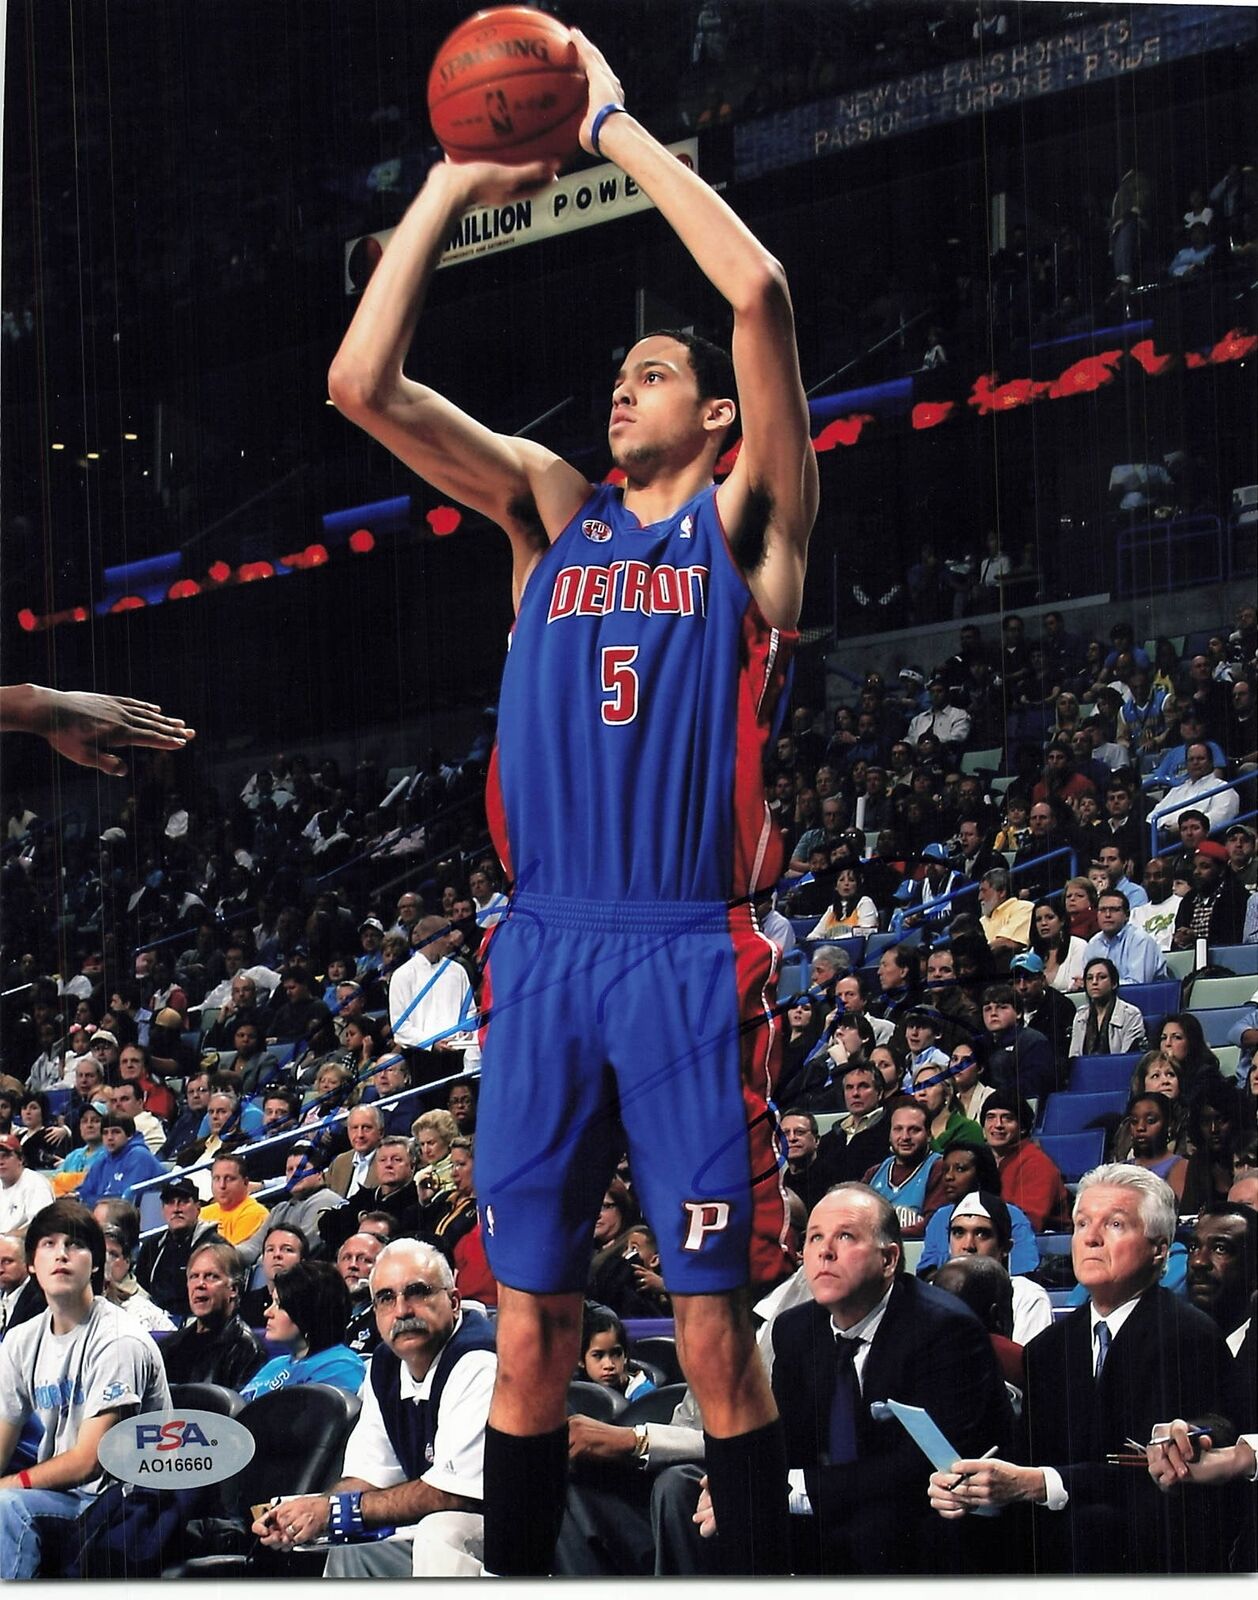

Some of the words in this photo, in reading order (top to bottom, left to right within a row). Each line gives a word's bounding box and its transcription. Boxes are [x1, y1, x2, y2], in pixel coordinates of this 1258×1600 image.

[439, 38, 550, 86] SPALDING
[840, 84, 891, 119] NEW
[443, 200, 532, 253] MILLION
[547, 560, 709, 625] DETROIT
[600, 645, 639, 726] 5
[682, 1201, 730, 1252] P
